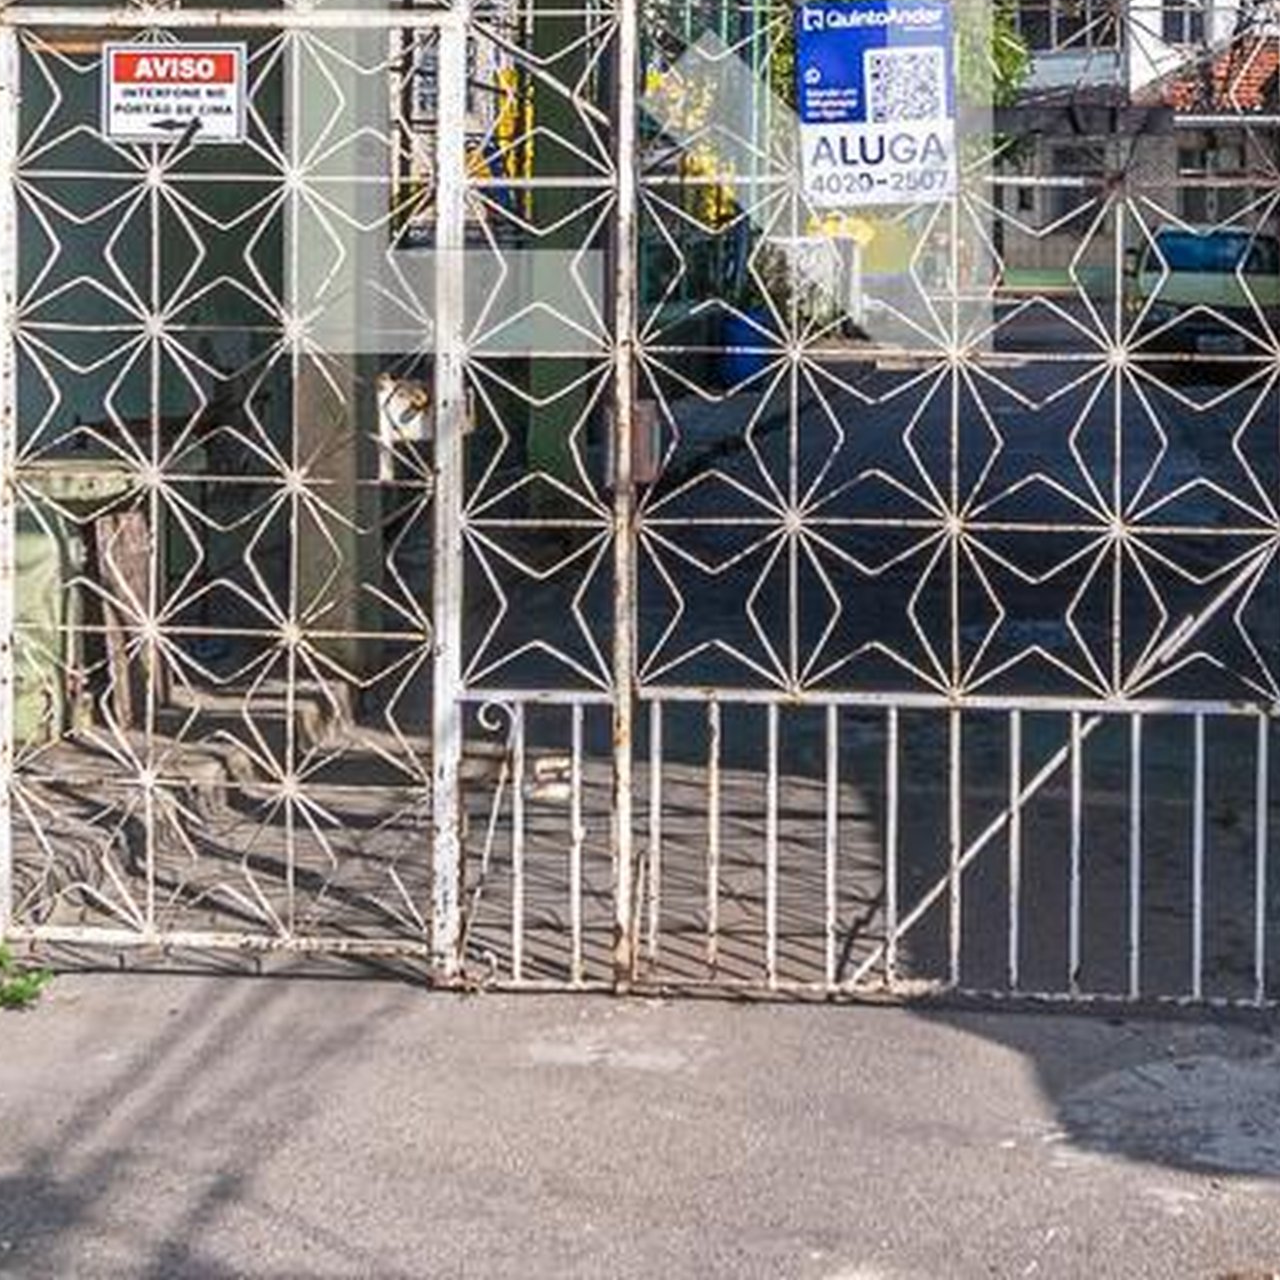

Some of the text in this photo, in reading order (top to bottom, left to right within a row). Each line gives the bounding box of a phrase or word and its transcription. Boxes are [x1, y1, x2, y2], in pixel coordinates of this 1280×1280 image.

[826, 6, 944, 27] QuintoAndar
[134, 56, 216, 80] AVISO
[122, 87, 201, 99] INTERFONE
[176, 104, 194, 116] DE
[198, 104, 234, 116] CIMA
[811, 132, 948, 167] ALUGA
[810, 169, 949, 195] 4020-2507
